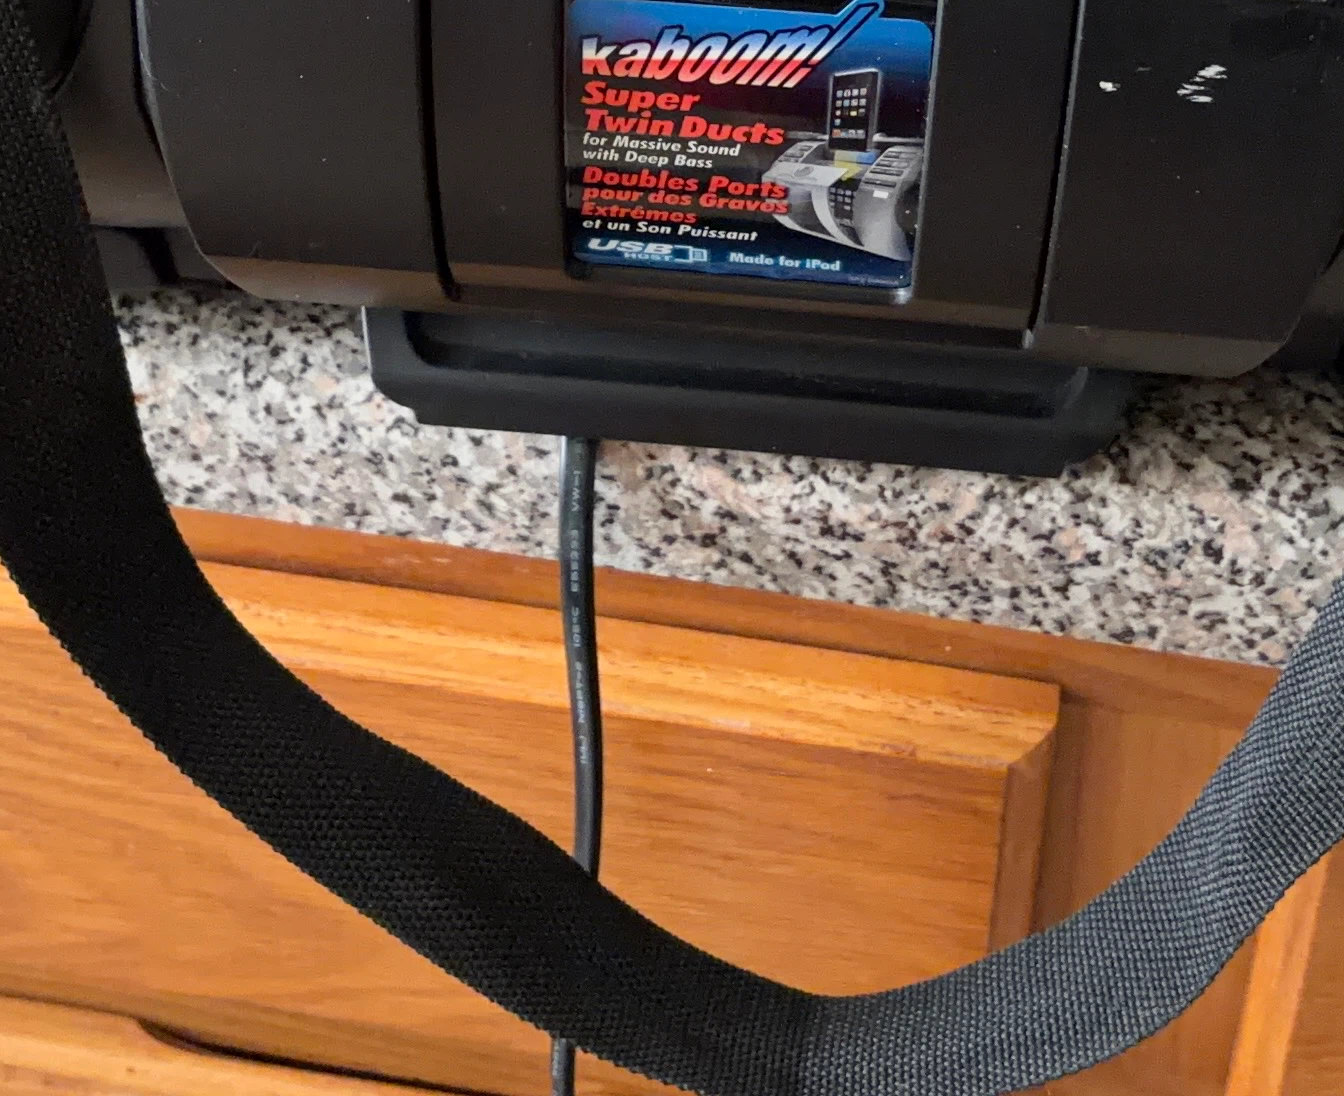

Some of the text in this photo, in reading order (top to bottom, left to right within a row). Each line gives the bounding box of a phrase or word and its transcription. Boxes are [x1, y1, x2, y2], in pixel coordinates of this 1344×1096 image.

[580, 2, 882, 89] kaboom!
[580, 80, 701, 112] Super
[585, 108, 785, 145] Twin Ducts
[582, 132, 741, 156] for Massive Sound
[582, 149, 713, 169] with Deep Bass
[582, 166, 789, 199] Doubles Ports
[582, 187, 789, 214] pour des Graves
[582, 219, 758, 242] et un Son Puissant
[587, 238, 675, 254] USB
[729, 252, 841, 272] Made for iPod
